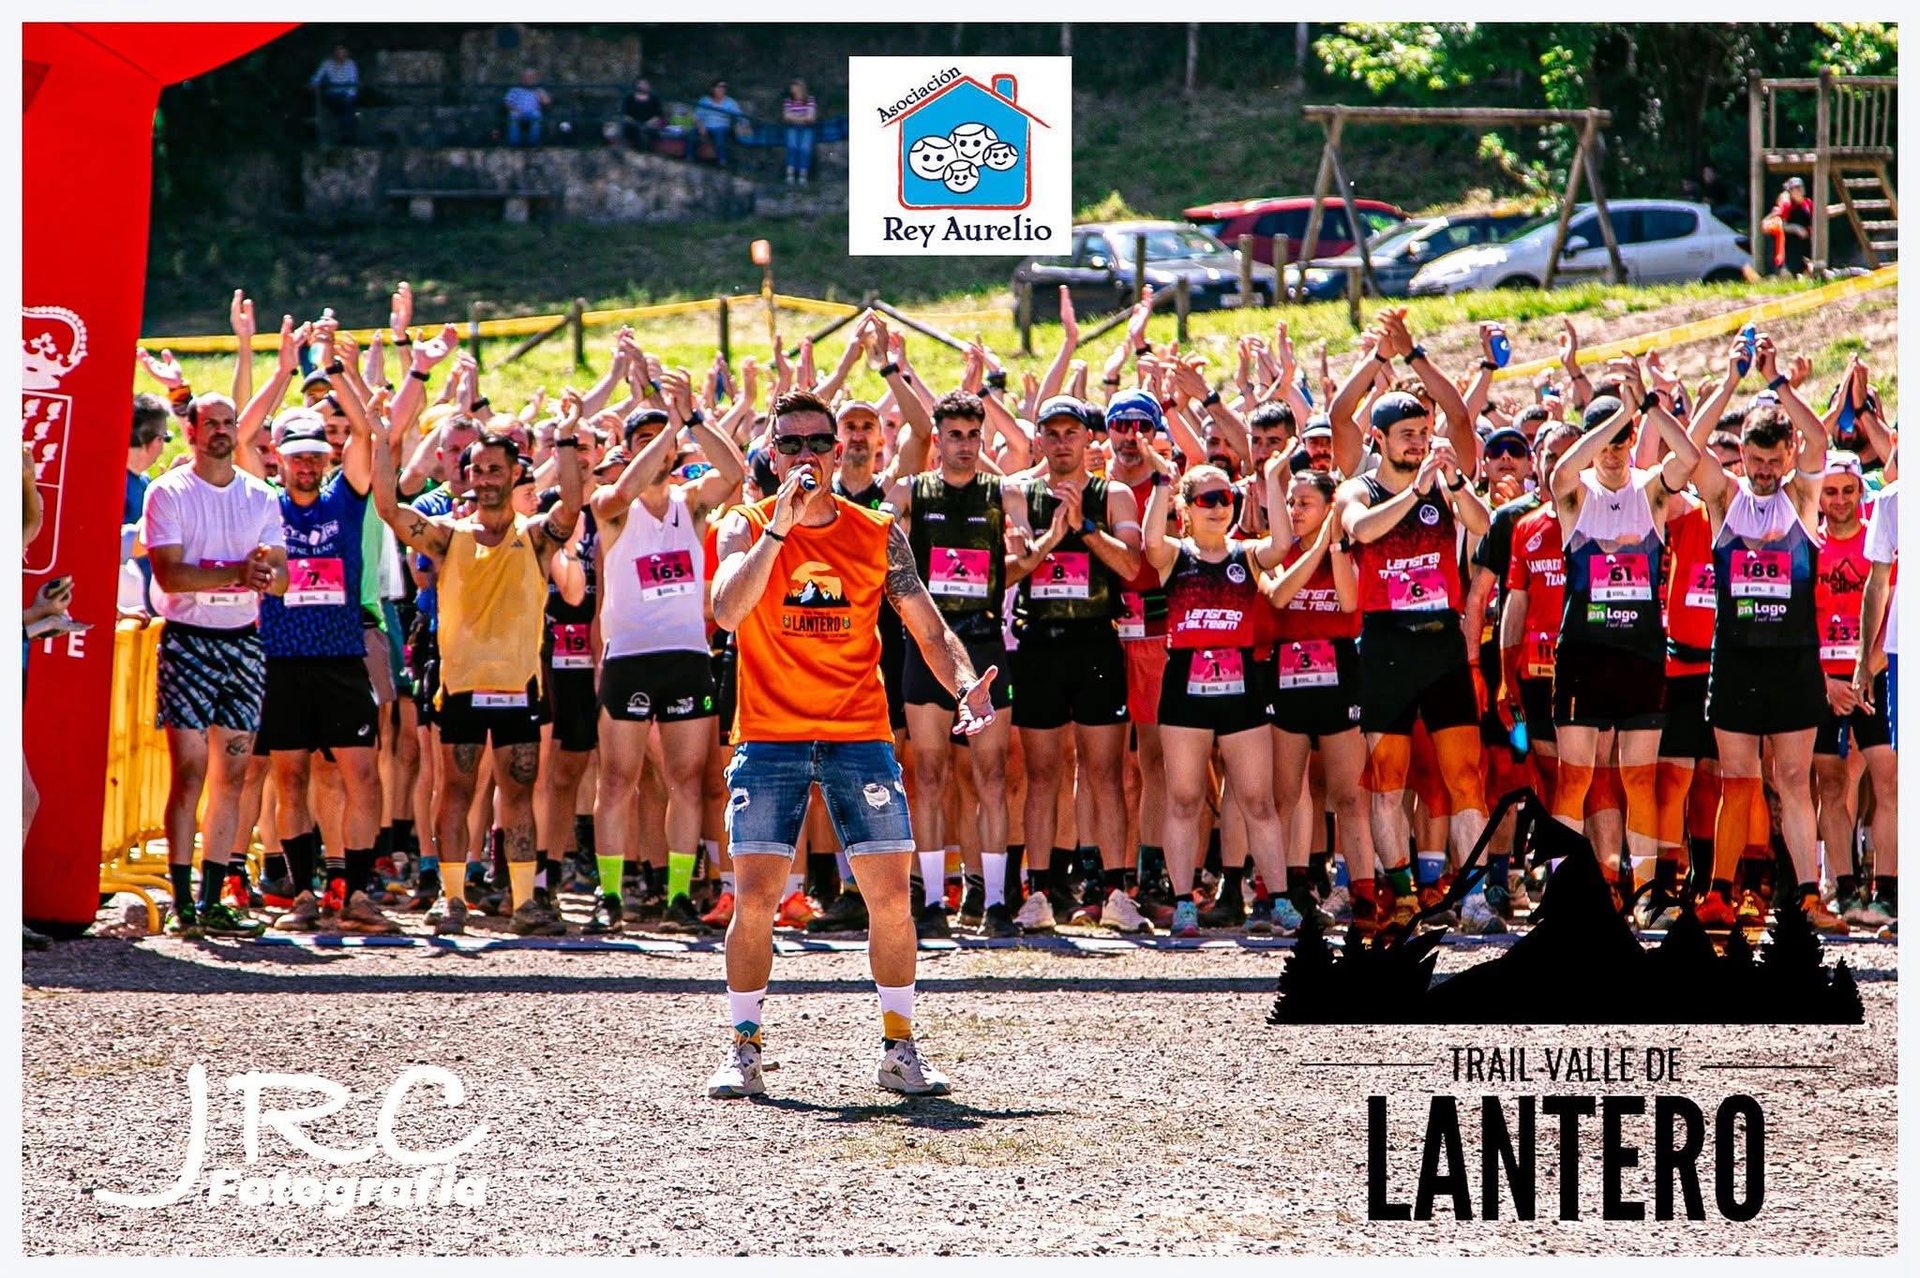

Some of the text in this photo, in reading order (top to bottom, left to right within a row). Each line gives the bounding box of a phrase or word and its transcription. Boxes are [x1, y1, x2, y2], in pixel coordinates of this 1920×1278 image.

[651, 563, 685, 581] 165
[1052, 565, 1064, 579] 8
[1610, 567, 1632, 581] 61
[1742, 562, 1778, 578] 188
[307, 571, 319, 586] 7
[1411, 583, 1424, 598] 6
[793, 615, 841, 632] LANTERO
[1302, 653, 1312, 668] 3
[1212, 662, 1220, 677] 1
